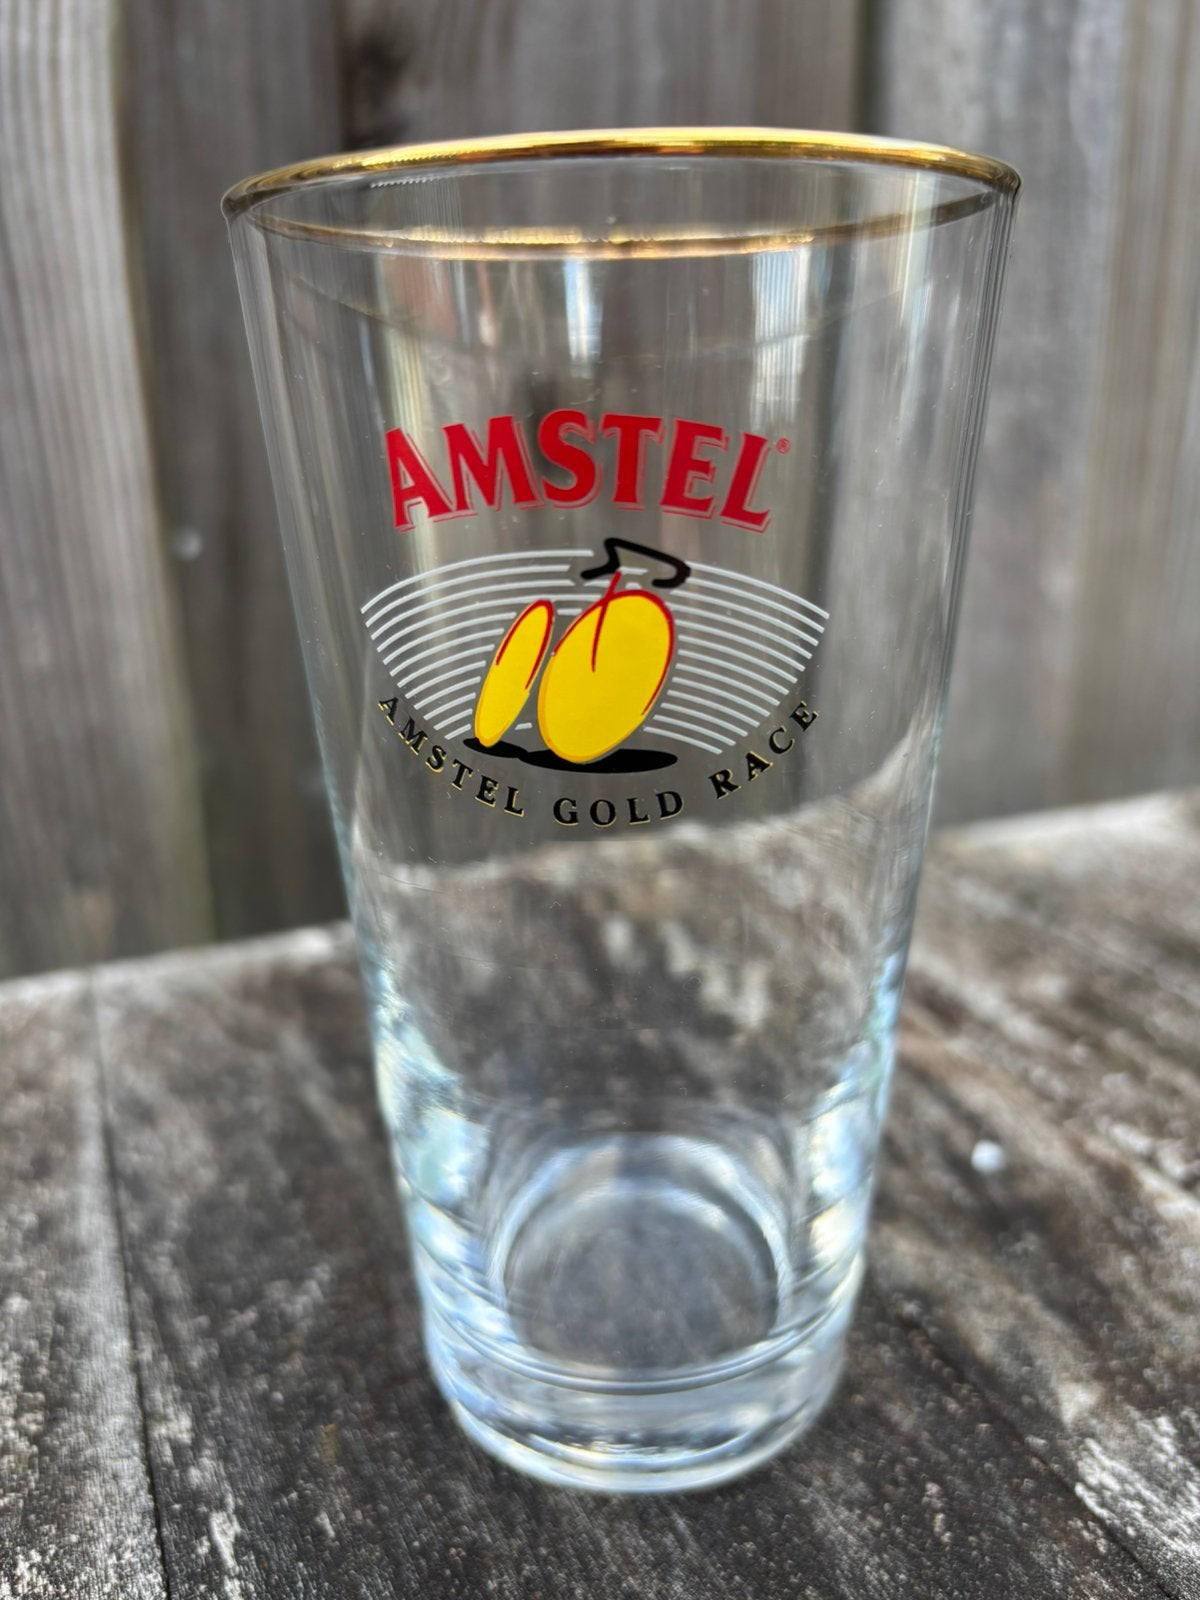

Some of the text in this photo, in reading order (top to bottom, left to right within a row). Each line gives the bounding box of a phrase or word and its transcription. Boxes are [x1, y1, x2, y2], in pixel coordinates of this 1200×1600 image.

[377, 697, 819, 828] AMSTEL GOLD RACE
